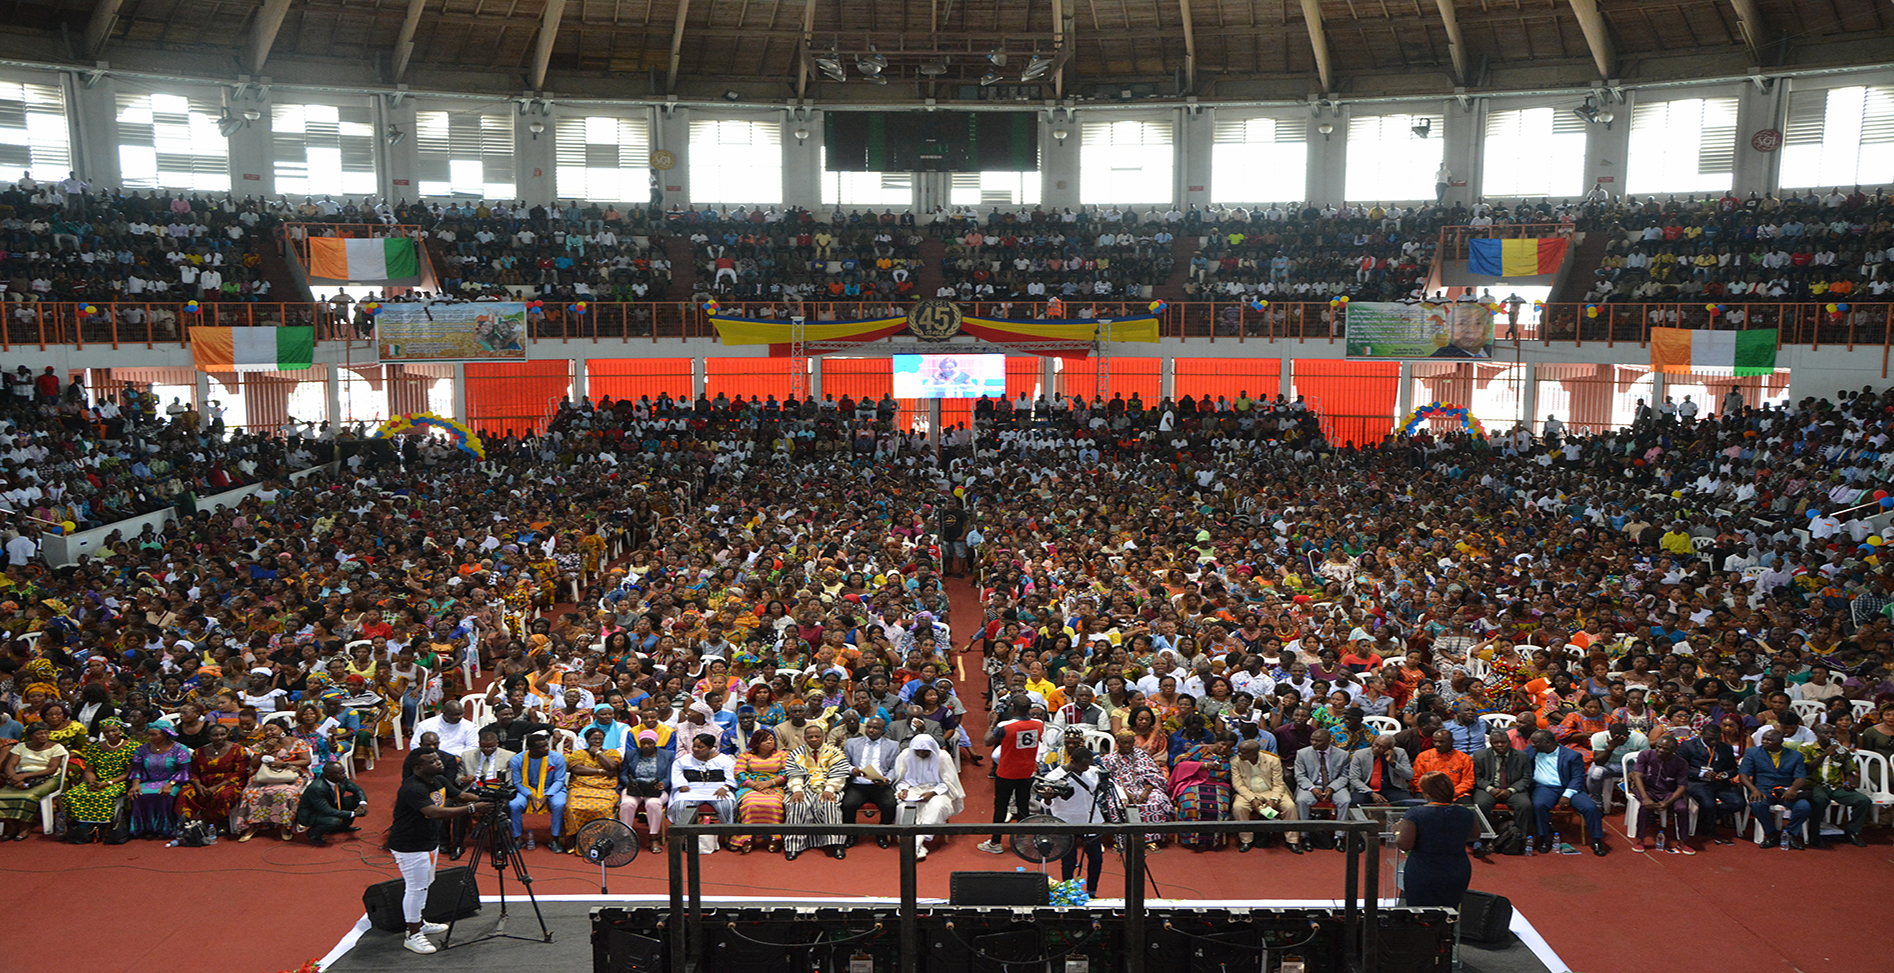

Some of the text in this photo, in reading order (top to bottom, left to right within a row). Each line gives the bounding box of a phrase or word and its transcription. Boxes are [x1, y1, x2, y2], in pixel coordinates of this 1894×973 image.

[1757, 135, 1777, 146] SGI
[918, 307, 950, 331] 45
[1022, 732, 1034, 746] 6
